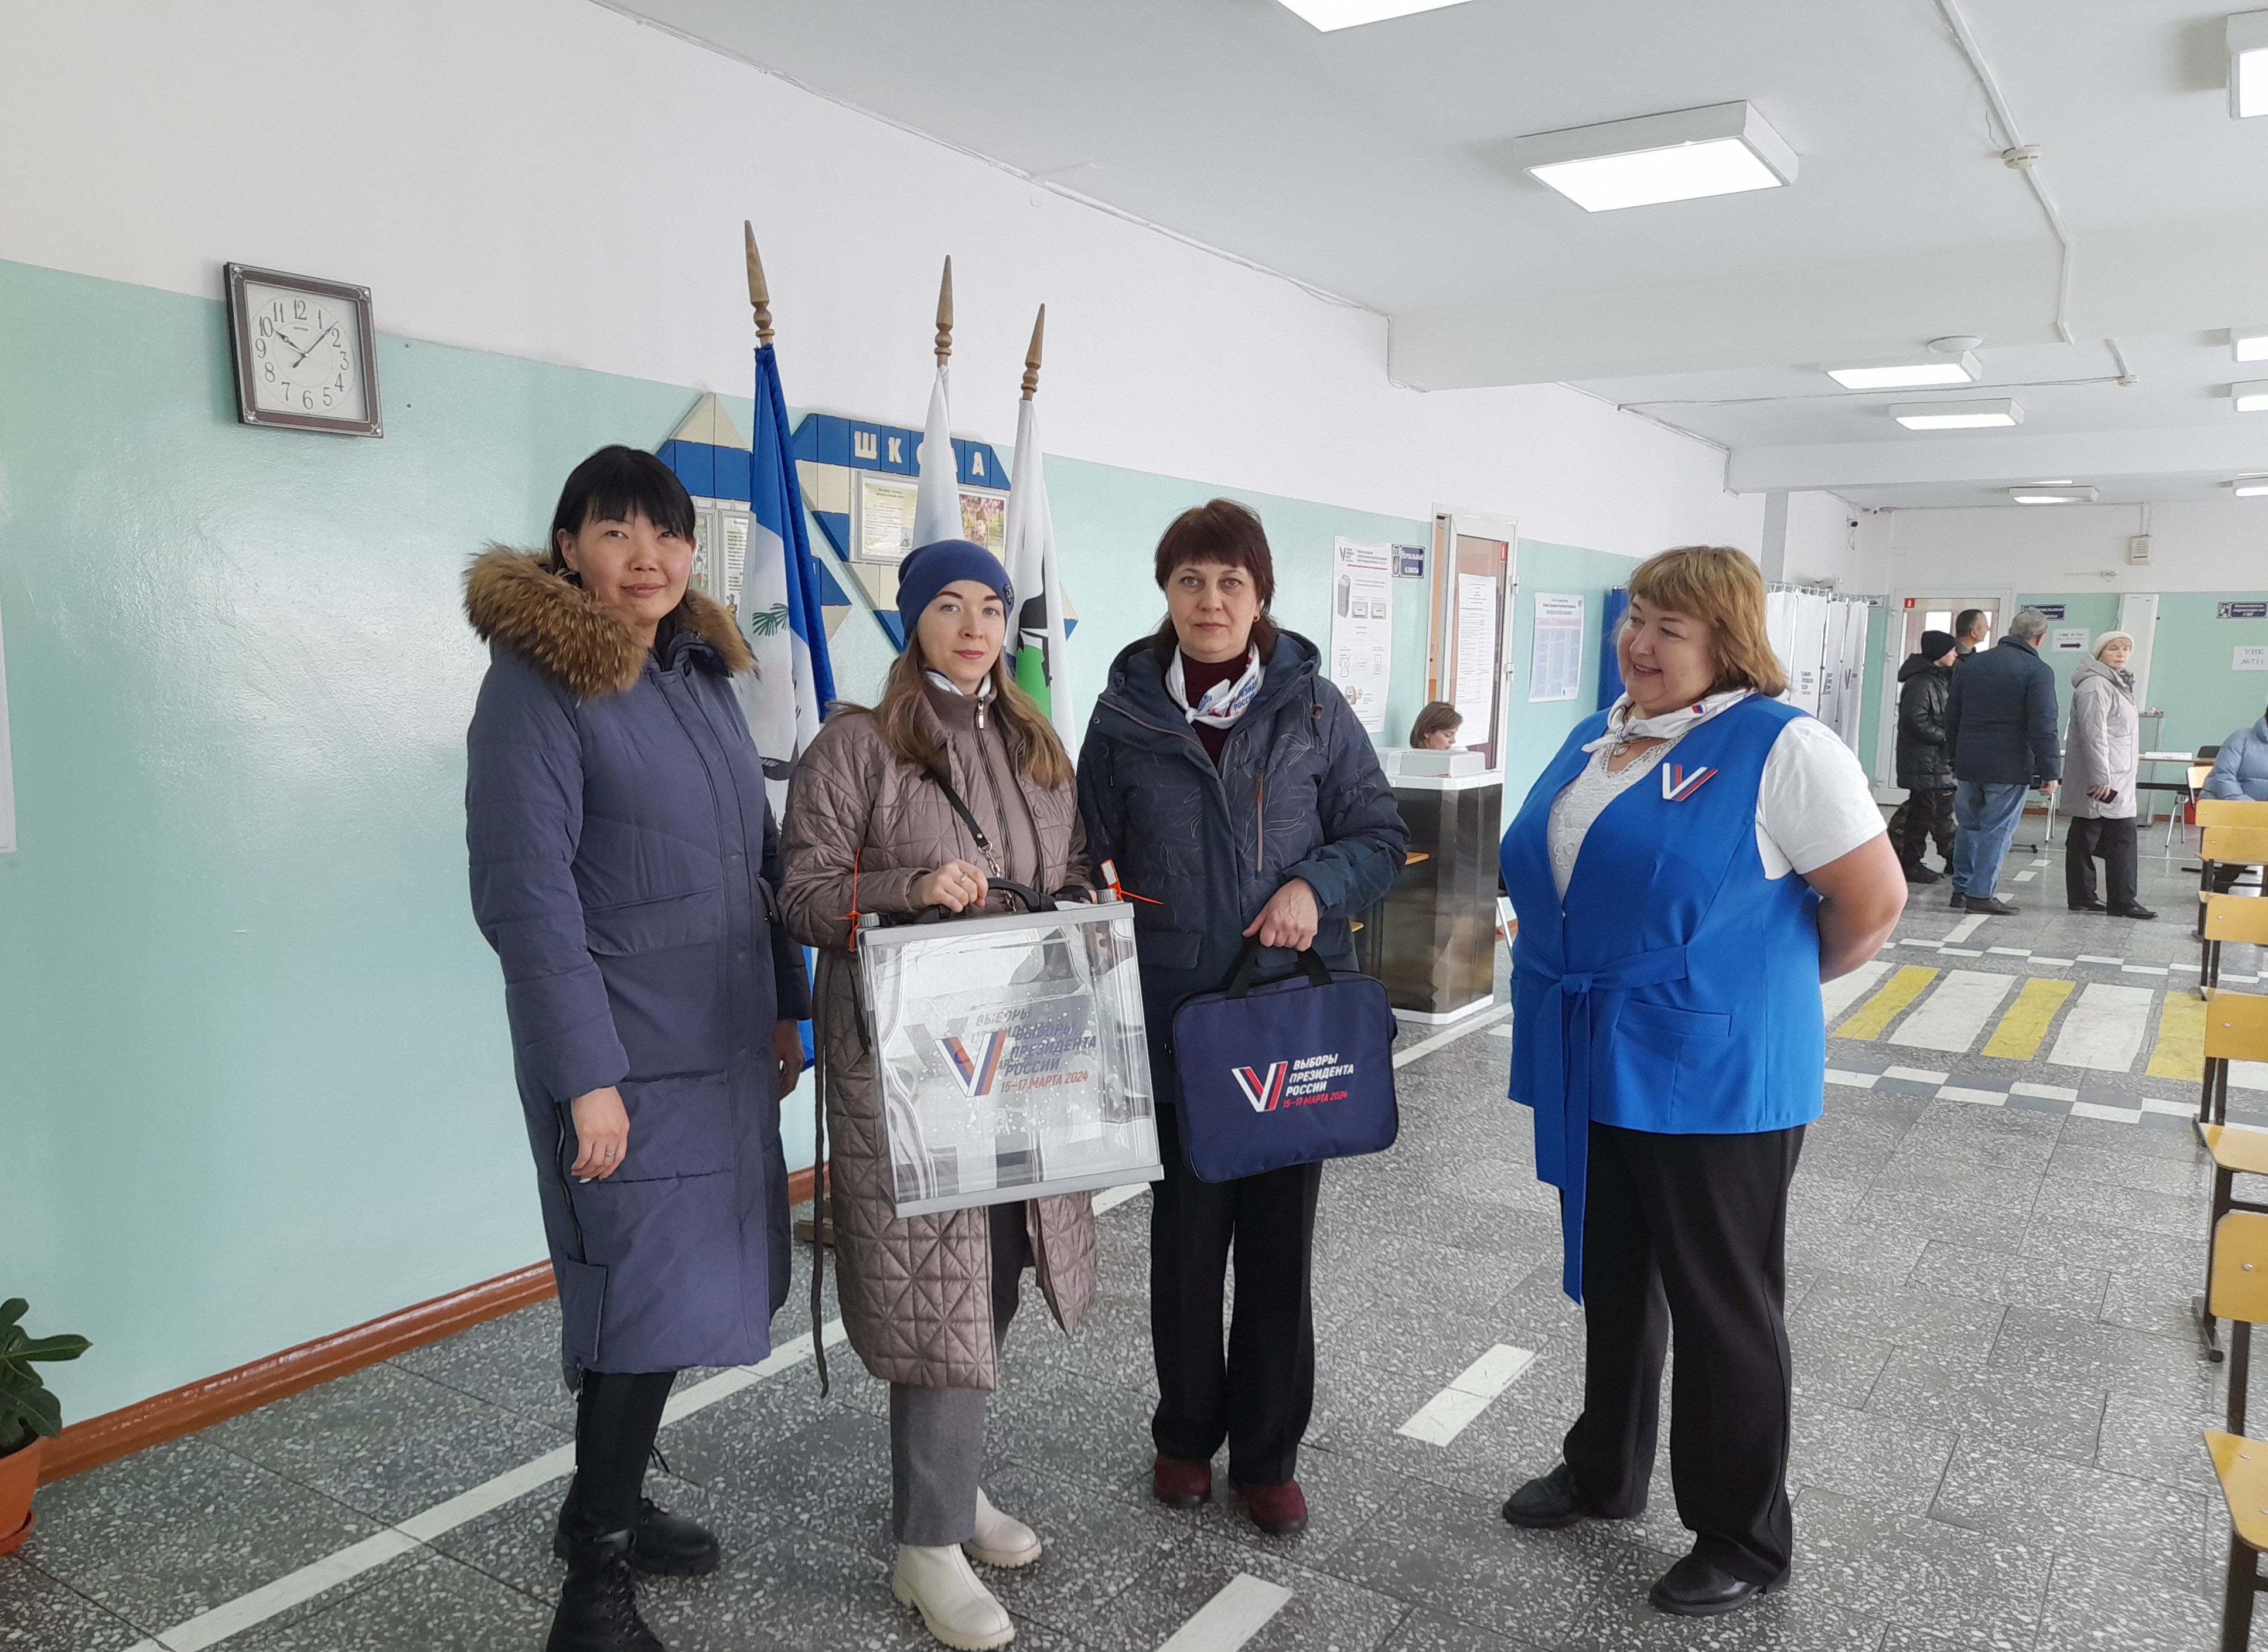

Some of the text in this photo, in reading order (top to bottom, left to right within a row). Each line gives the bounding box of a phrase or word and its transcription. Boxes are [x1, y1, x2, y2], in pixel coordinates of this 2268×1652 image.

[272, 301, 285, 322] 11
[294, 299, 308, 320] 12
[318, 309, 323, 329] 1
[258, 316, 273, 337] 10
[331, 328, 341, 348] 2
[255, 338, 267, 359] 9
[340, 351, 349, 370] 3
[264, 362, 275, 382] 8
[334, 372, 344, 391] 4
[281, 381, 291, 401] 7
[302, 390, 313, 410] 6
[323, 387, 332, 406] 5
[854, 431, 985, 476] ШКА
[1014, 1021, 1073, 1041] ВЫБОРЫ
[1009, 1035, 1096, 1061] ПРЕЗИДЕНТА
[1004, 1057, 1061, 1077] РОССИИ
[1292, 1052, 1339, 1071] ВЫБОРЫ
[1029, 1073, 1062, 1089] МАРТА
[1063, 1069, 1089, 1084] 2024
[1289, 1064, 1355, 1084] ПРЕЗИДЕНТА
[1285, 1081, 1328, 1097] РОССИИ
[1304, 1093, 1329, 1106] МАРТА
[1329, 1090, 1349, 1102] 2024
